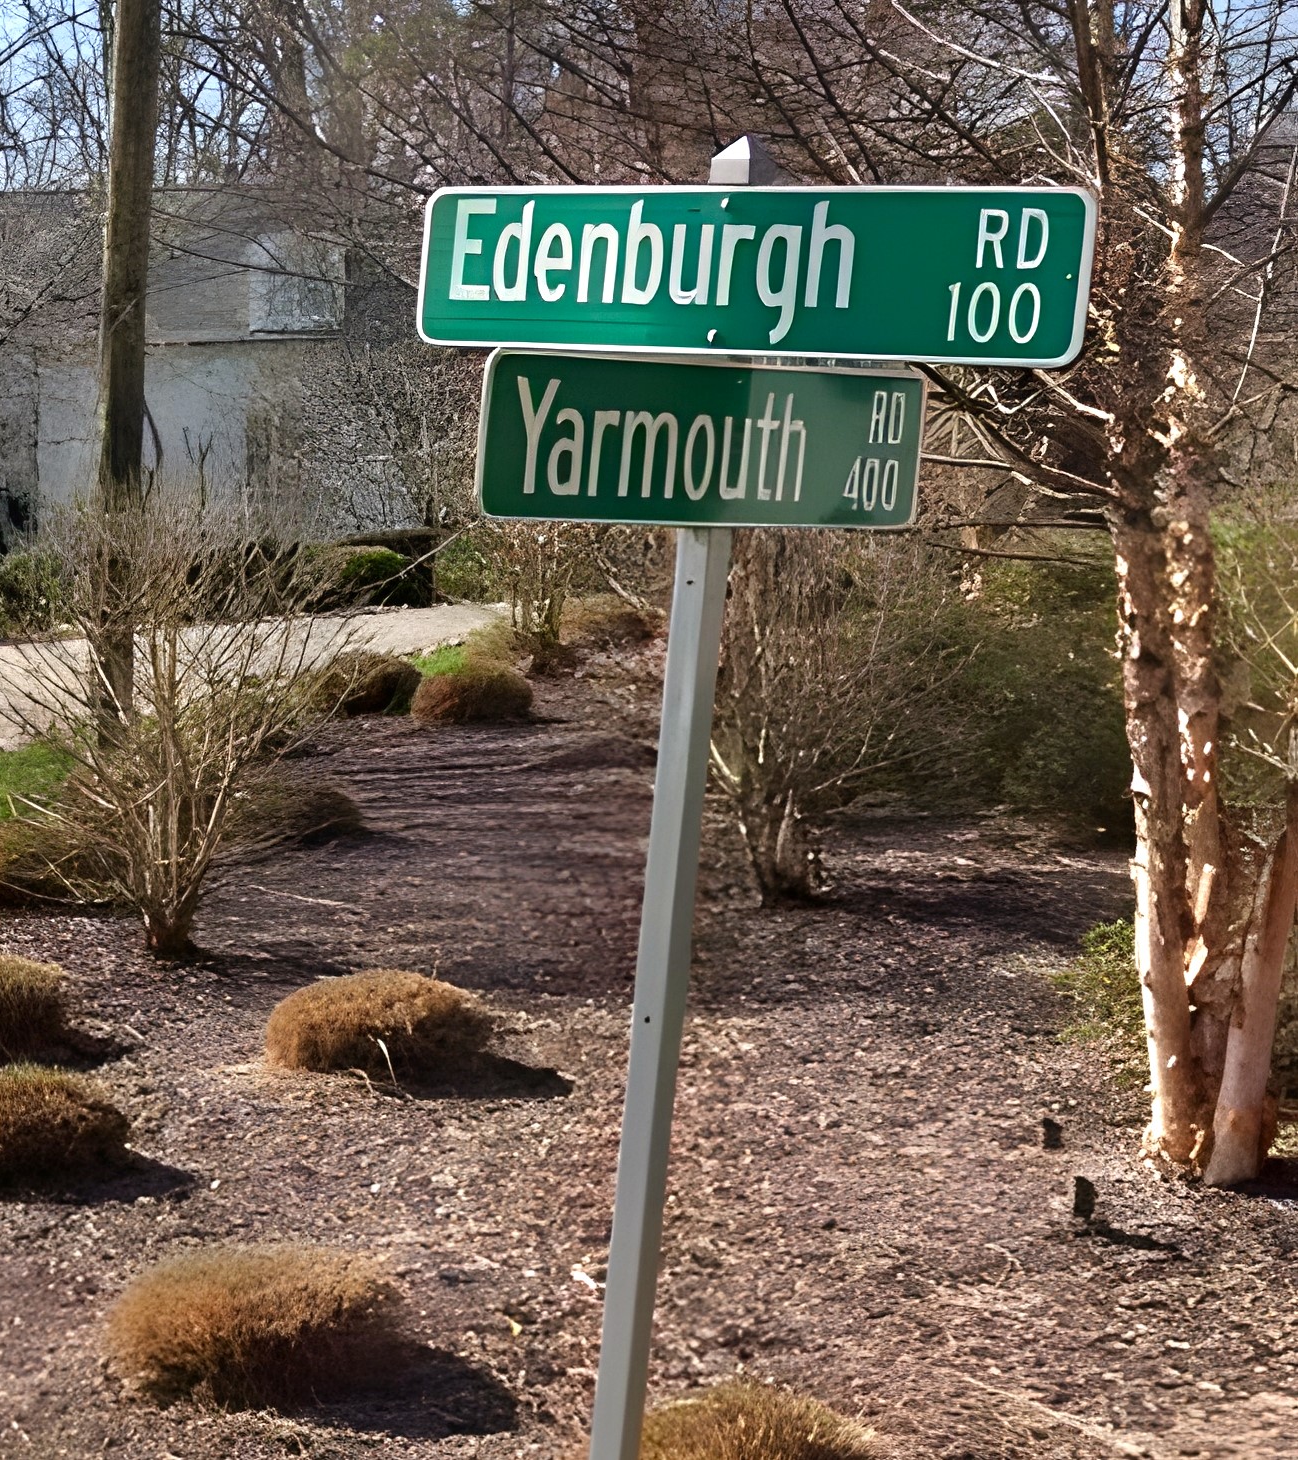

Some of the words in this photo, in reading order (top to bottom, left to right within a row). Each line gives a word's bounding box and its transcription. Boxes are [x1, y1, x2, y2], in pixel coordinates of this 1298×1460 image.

[449, 198, 856, 345] Edenburgh
[976, 208, 1049, 269] RD
[947, 282, 1041, 344] 100
[517, 377, 806, 501] Yarmouth
[869, 391, 906, 444] RD
[843, 456, 899, 511] 400
